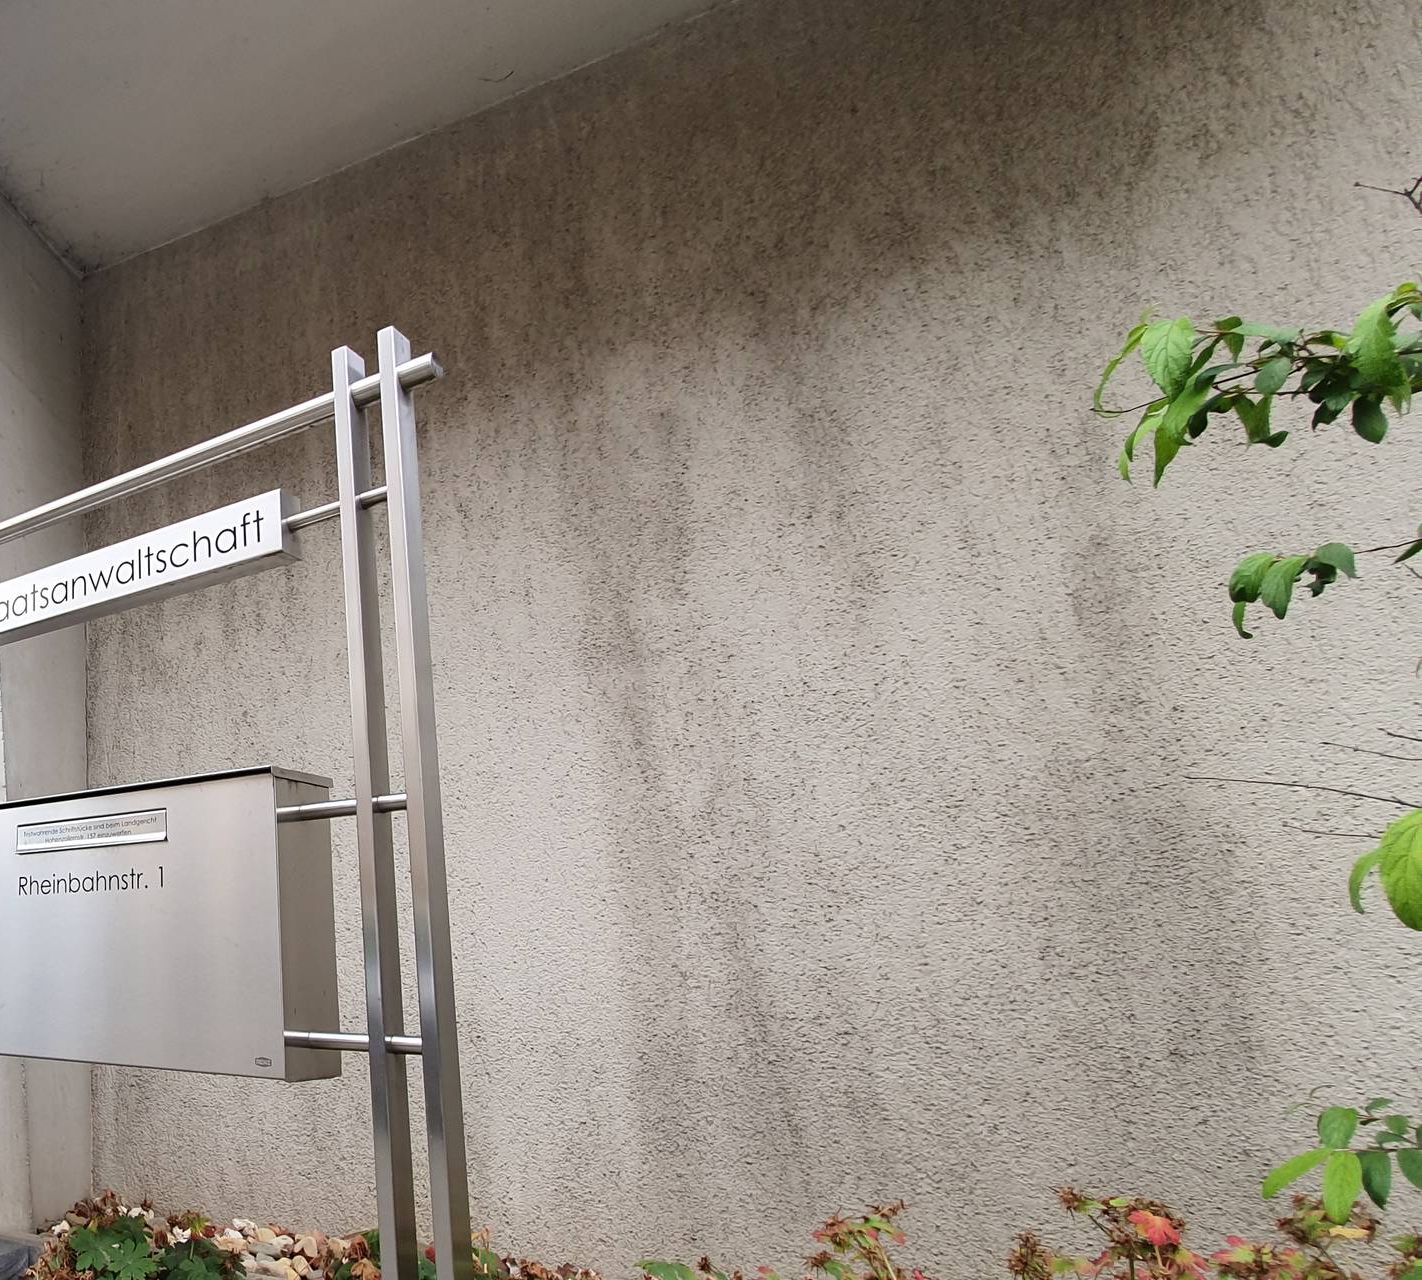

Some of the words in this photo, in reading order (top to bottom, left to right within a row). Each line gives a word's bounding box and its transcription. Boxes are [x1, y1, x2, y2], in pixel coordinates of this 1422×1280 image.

[93, 822, 105, 831] sind
[105, 822, 121, 830] beim
[121, 816, 157, 828] Landgericht
[18, 867, 149, 896] Rheinbahnstr.
[158, 866, 164, 888] 1
